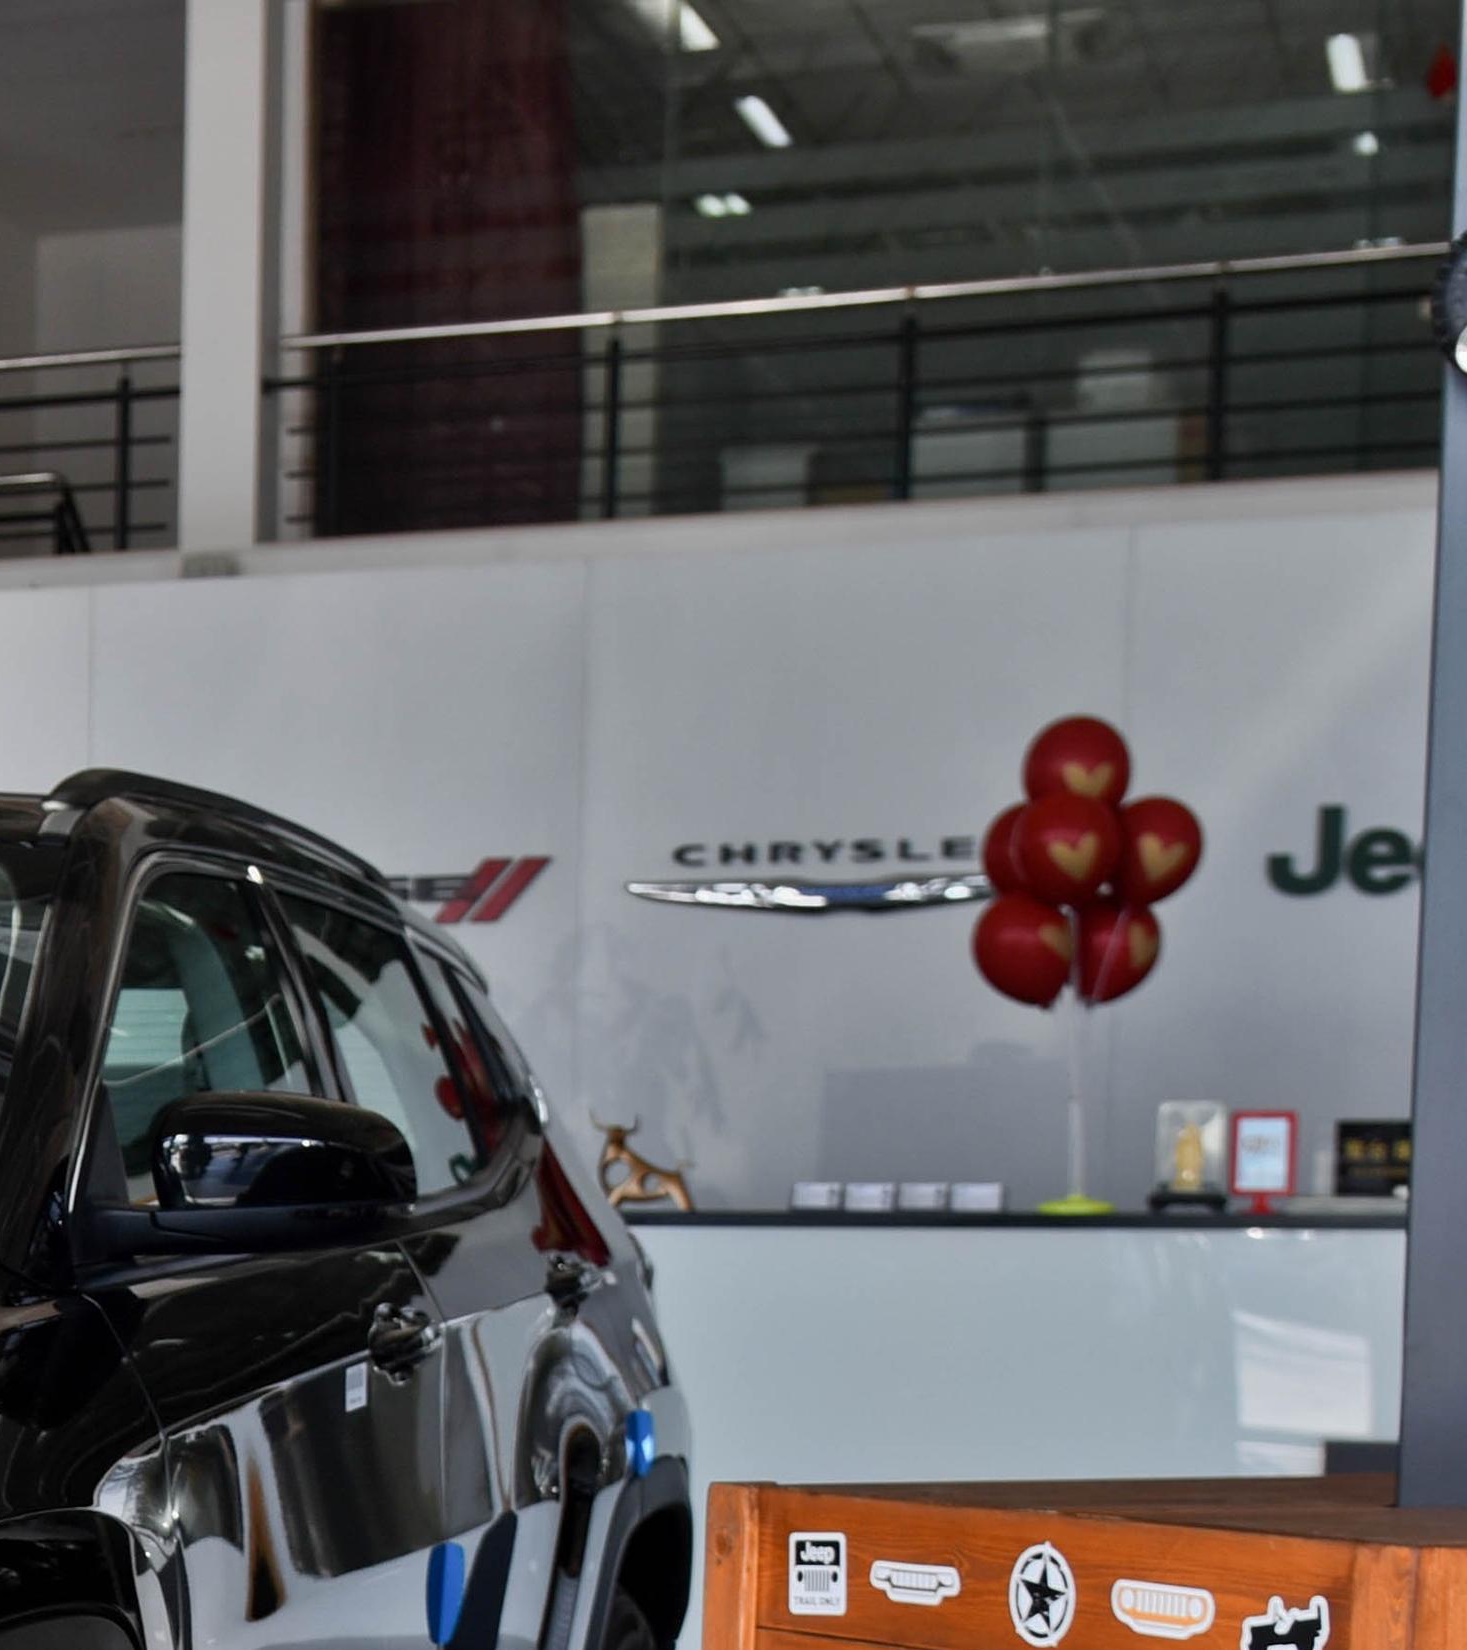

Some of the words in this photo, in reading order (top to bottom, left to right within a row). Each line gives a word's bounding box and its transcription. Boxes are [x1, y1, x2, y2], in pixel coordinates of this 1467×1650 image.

[672, 836, 976, 868] CHRYSLE
[1266, 804, 1424, 896] Je
[800, 1541, 836, 1565] Jeep
